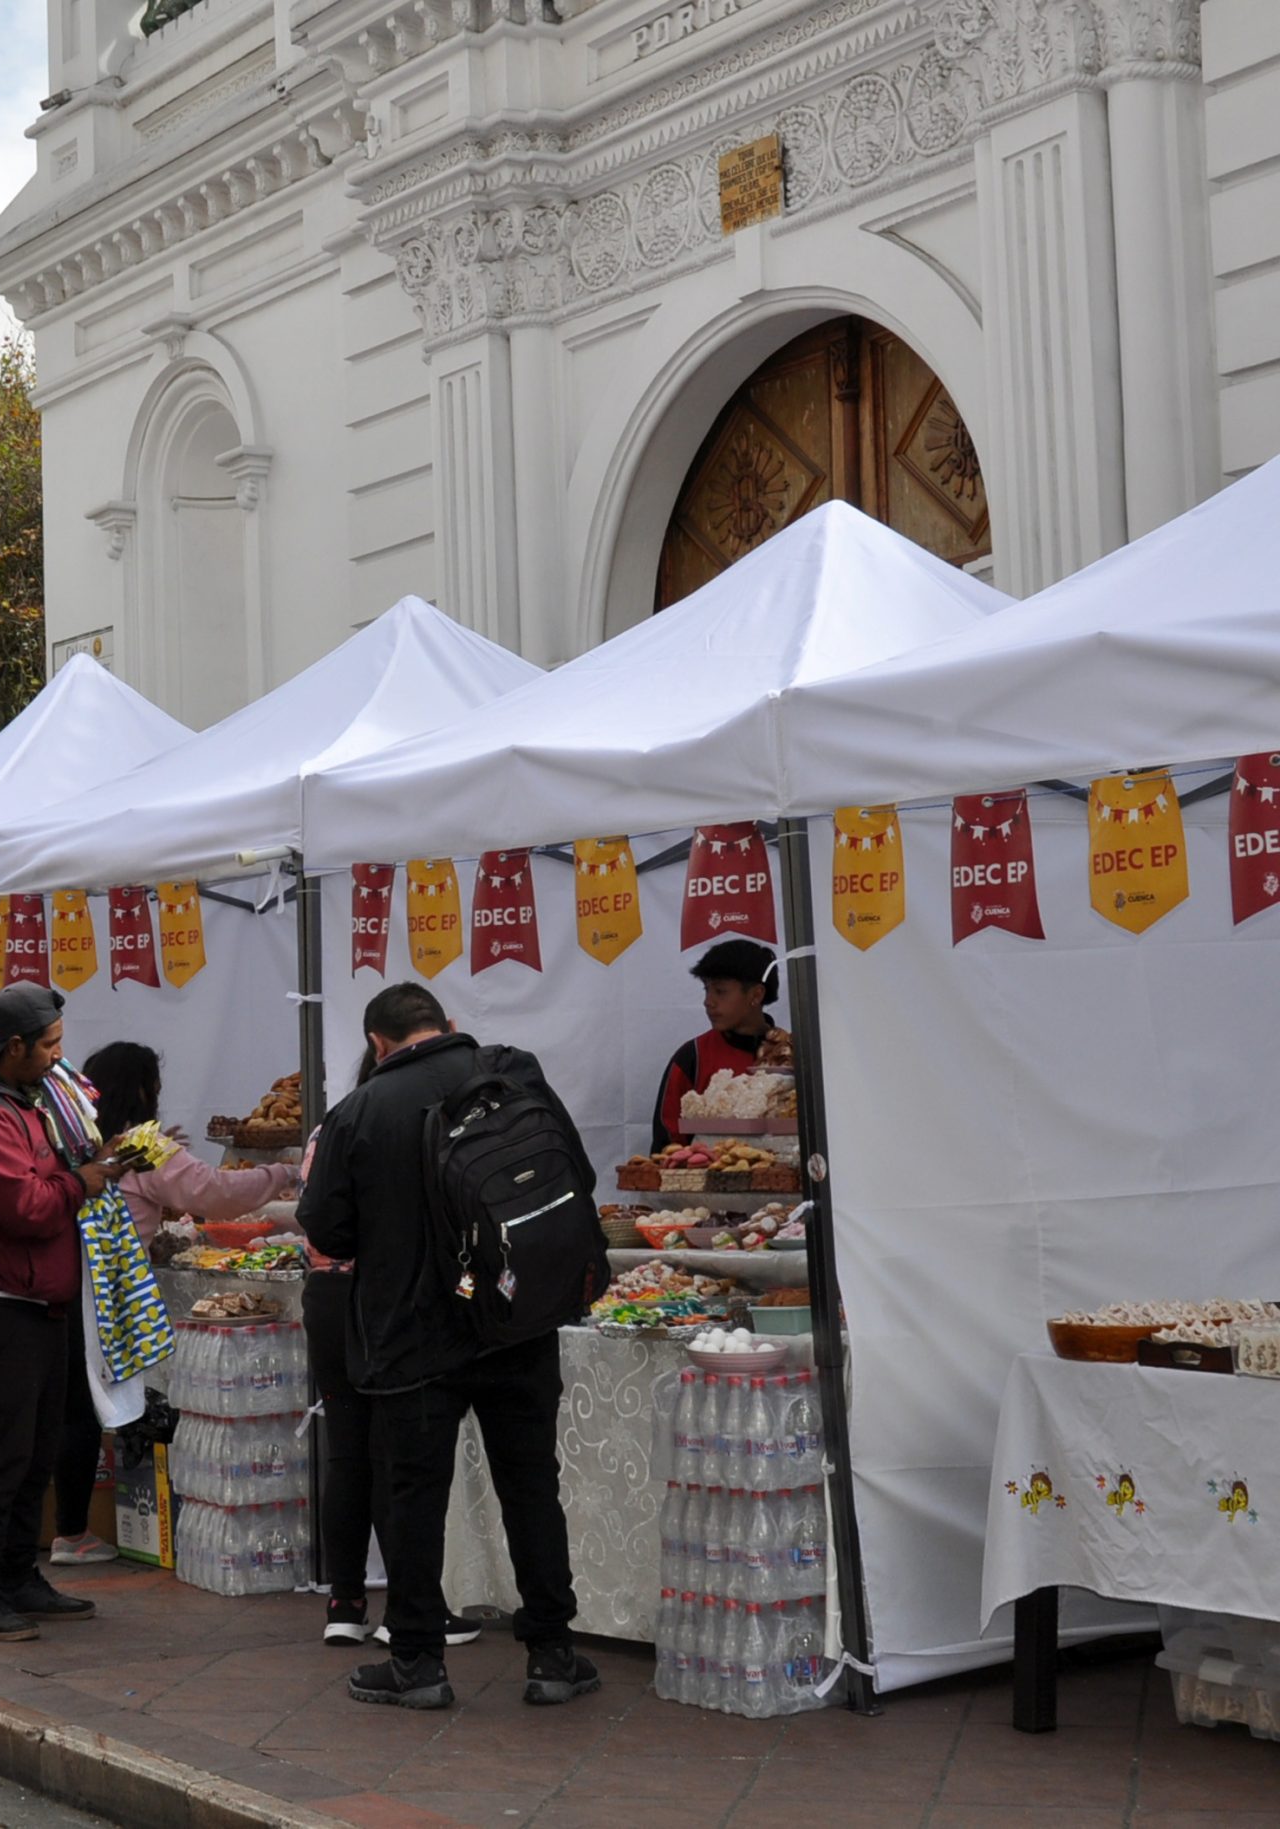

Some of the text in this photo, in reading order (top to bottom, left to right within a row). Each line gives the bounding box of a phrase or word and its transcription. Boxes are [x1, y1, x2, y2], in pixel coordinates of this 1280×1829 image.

[1234, 830, 1280, 858] EDE
[1093, 844, 1178, 875] EDEC EP
[952, 861, 1029, 887] EDEC EP
[688, 872, 767, 898] EDEC EP
[833, 872, 899, 895] EDEC EP
[577, 892, 632, 918] EDEC EP
[1127, 893, 1155, 902] CUENCA
[474, 906, 533, 927] EDEC EP
[984, 907, 1011, 916] CUENCA
[352, 917, 390, 934] DEC E
[441, 914, 457, 931] EP
[6, 939, 35, 953] DEC
[52, 937, 94, 953] DEC EP
[110, 933, 150, 951] DEC EP
[161, 929, 199, 947] DEC EP
